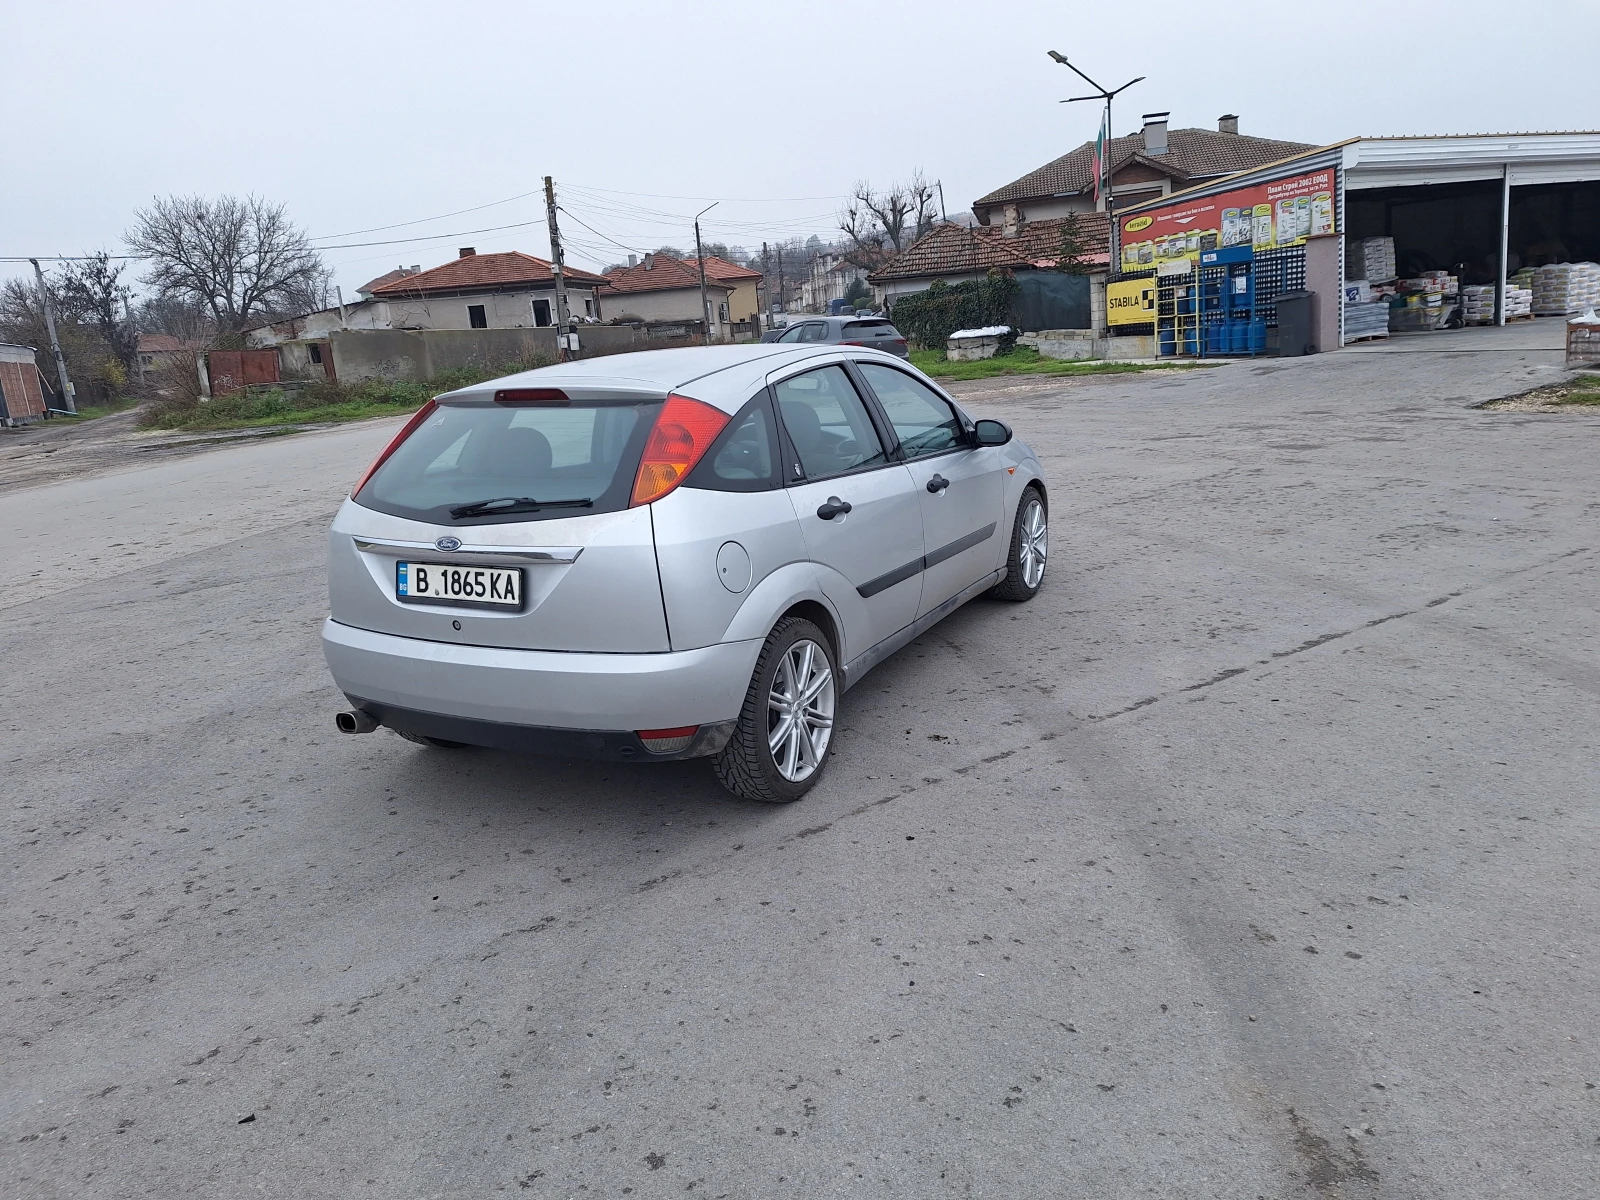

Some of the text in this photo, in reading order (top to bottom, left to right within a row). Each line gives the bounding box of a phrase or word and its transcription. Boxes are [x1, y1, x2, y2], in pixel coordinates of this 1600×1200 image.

[1267, 173, 1328, 194] Плам Строй 2002 ЕООД
[1109, 296, 1139, 309] STABILA
[399, 583, 407, 591] BG
